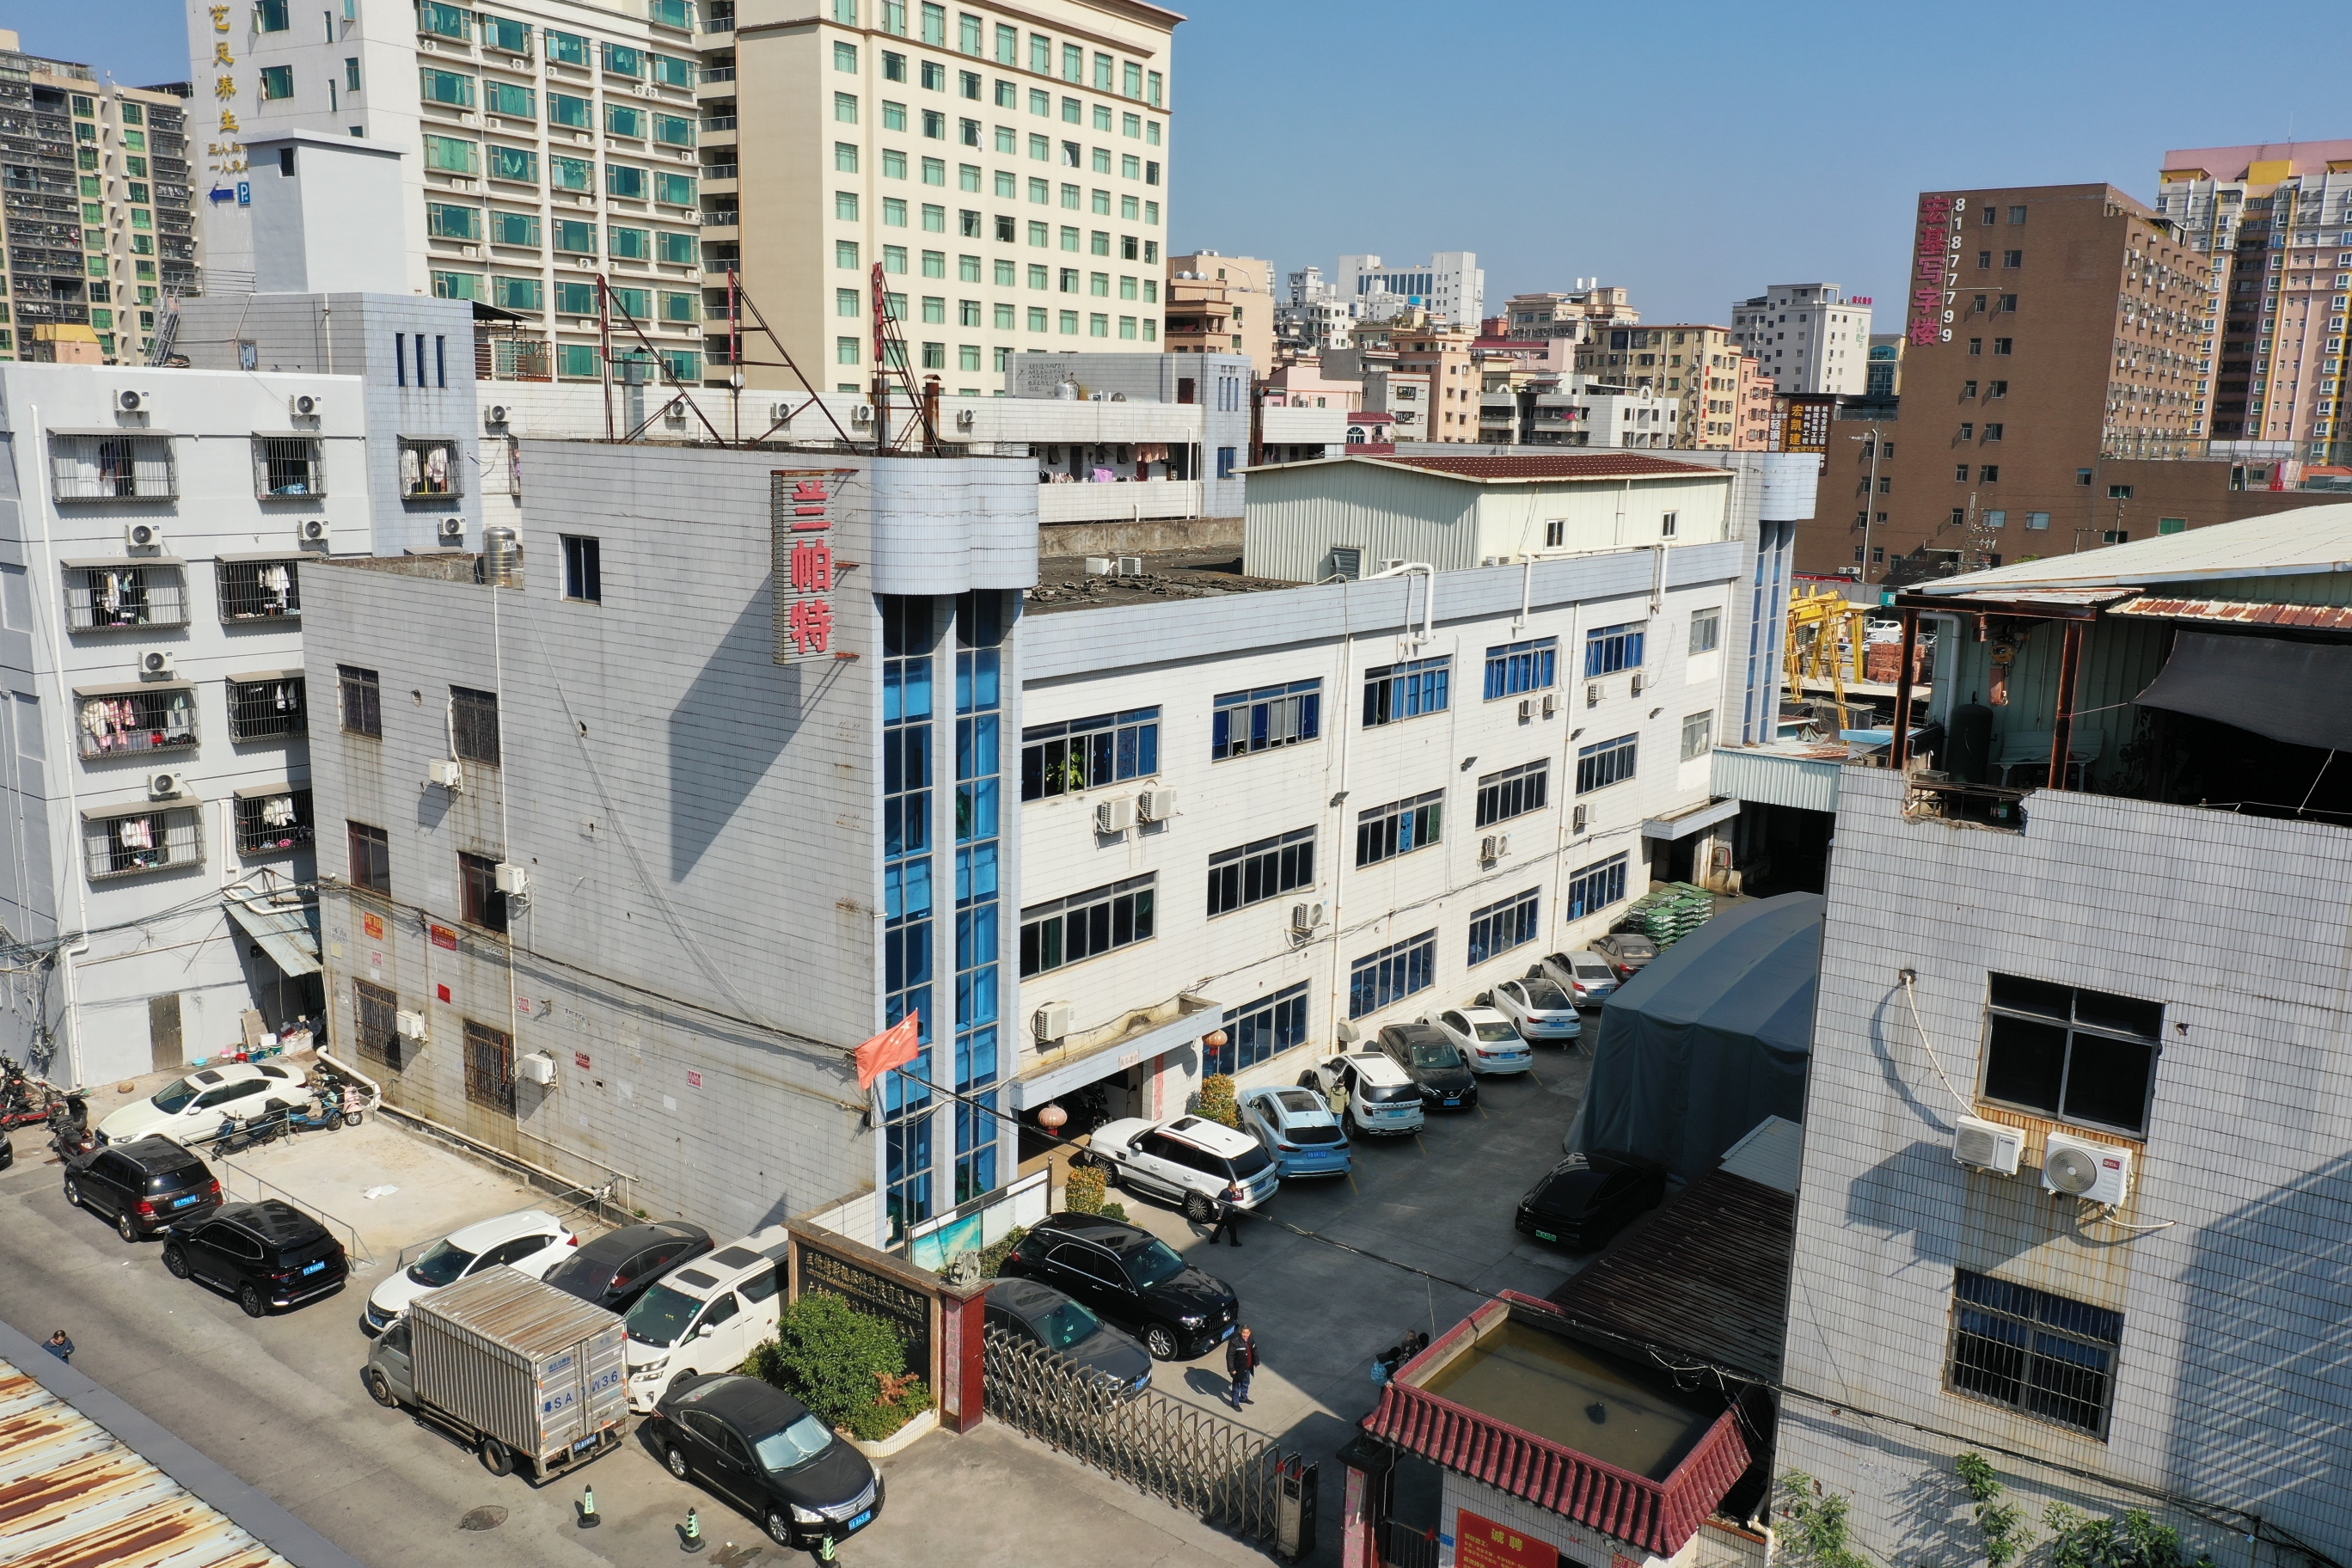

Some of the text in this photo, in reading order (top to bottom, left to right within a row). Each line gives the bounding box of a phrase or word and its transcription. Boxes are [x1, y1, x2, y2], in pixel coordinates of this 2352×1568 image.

[241, 184, 248, 202] P
[1909, 195, 1951, 346] 宏基写字楼
[1941, 198, 1966, 342] 81877799
[790, 480, 832, 653] 兰帕特
[1491, 1528, 1523, 1551] 诚聘
